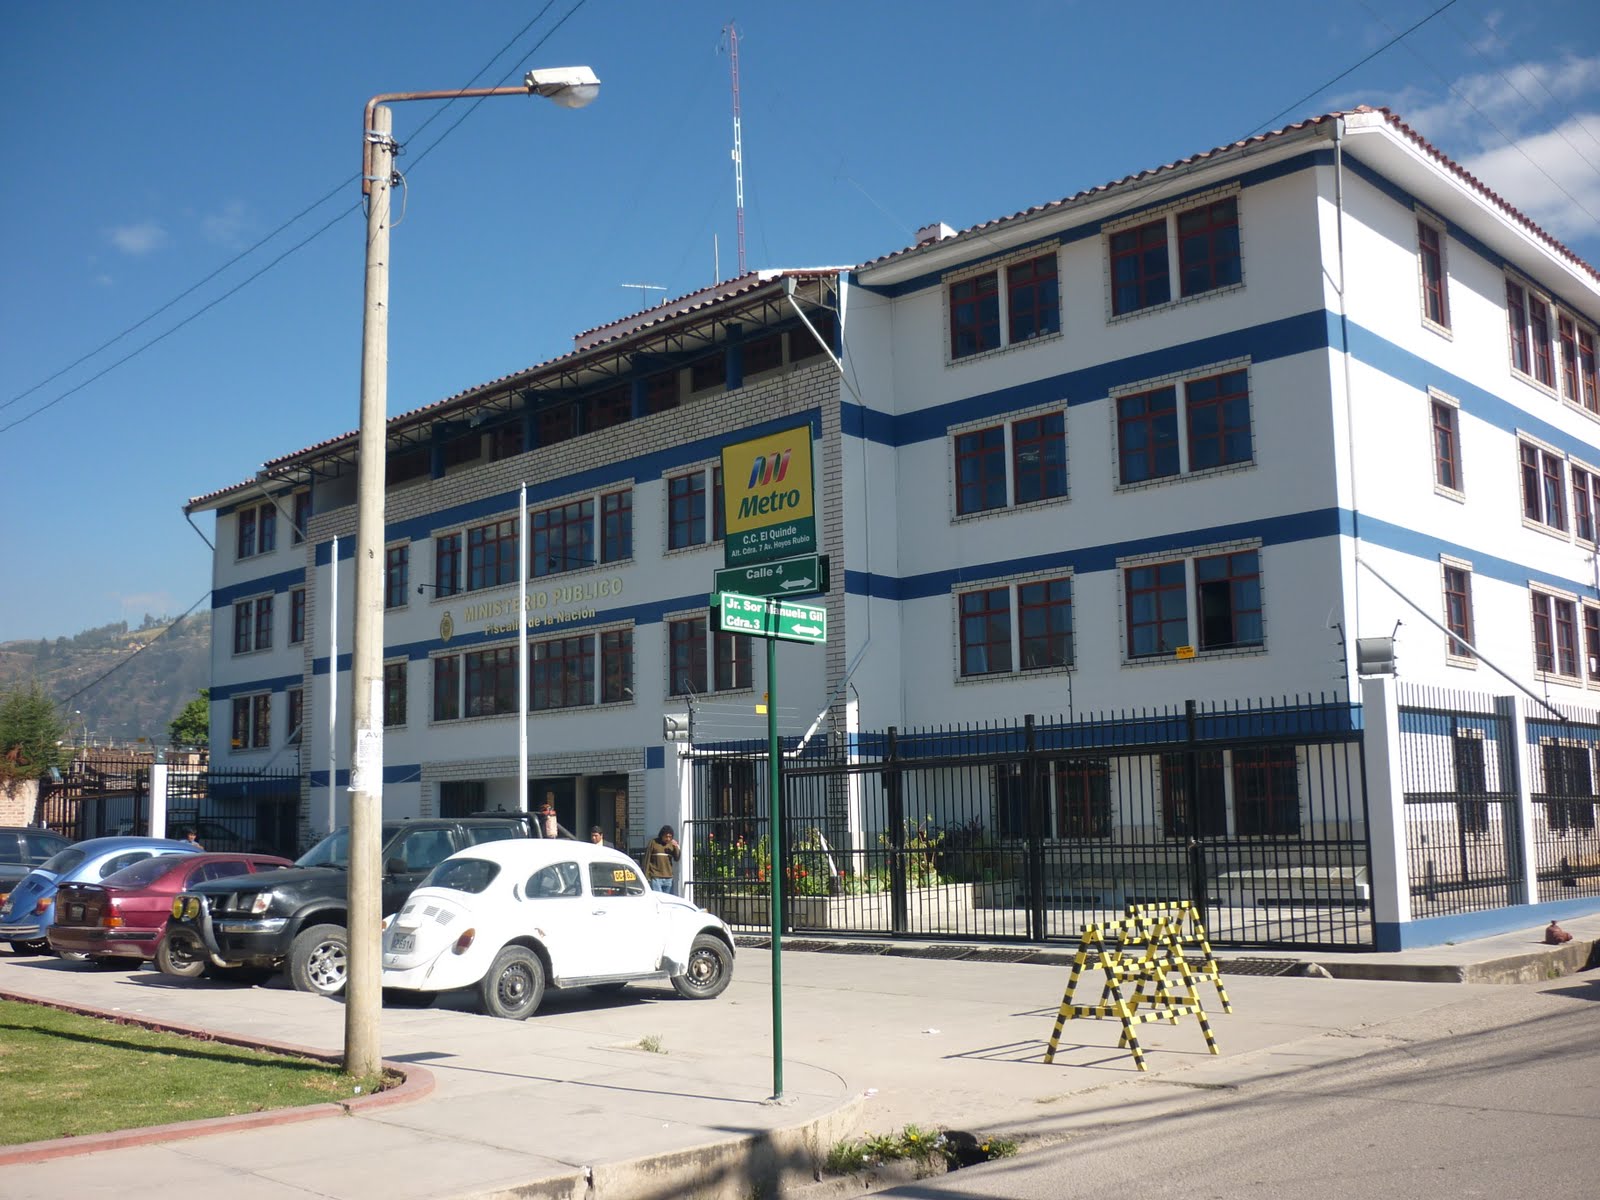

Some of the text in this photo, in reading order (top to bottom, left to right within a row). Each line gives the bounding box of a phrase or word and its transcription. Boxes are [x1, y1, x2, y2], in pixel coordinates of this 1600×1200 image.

[738, 489, 801, 520] Metro
[731, 550, 741, 558] Alt.
[742, 546, 758, 555] Cdra.
[763, 542, 773, 550] Av.
[773, 540, 791, 549] Hoyos
[792, 535, 810, 545] Rubio
[743, 526, 797, 545] C.C. El Quinde
[746, 565, 783, 579] Calle 4
[528, 615, 541, 628] de
[544, 613, 553, 625] la
[556, 606, 597, 623] Nación
[726, 599, 742, 609] Jr.
[743, 600, 762, 612] Sor
[809, 610, 823, 622] Gil
[726, 615, 760, 629] Cdra. 3
